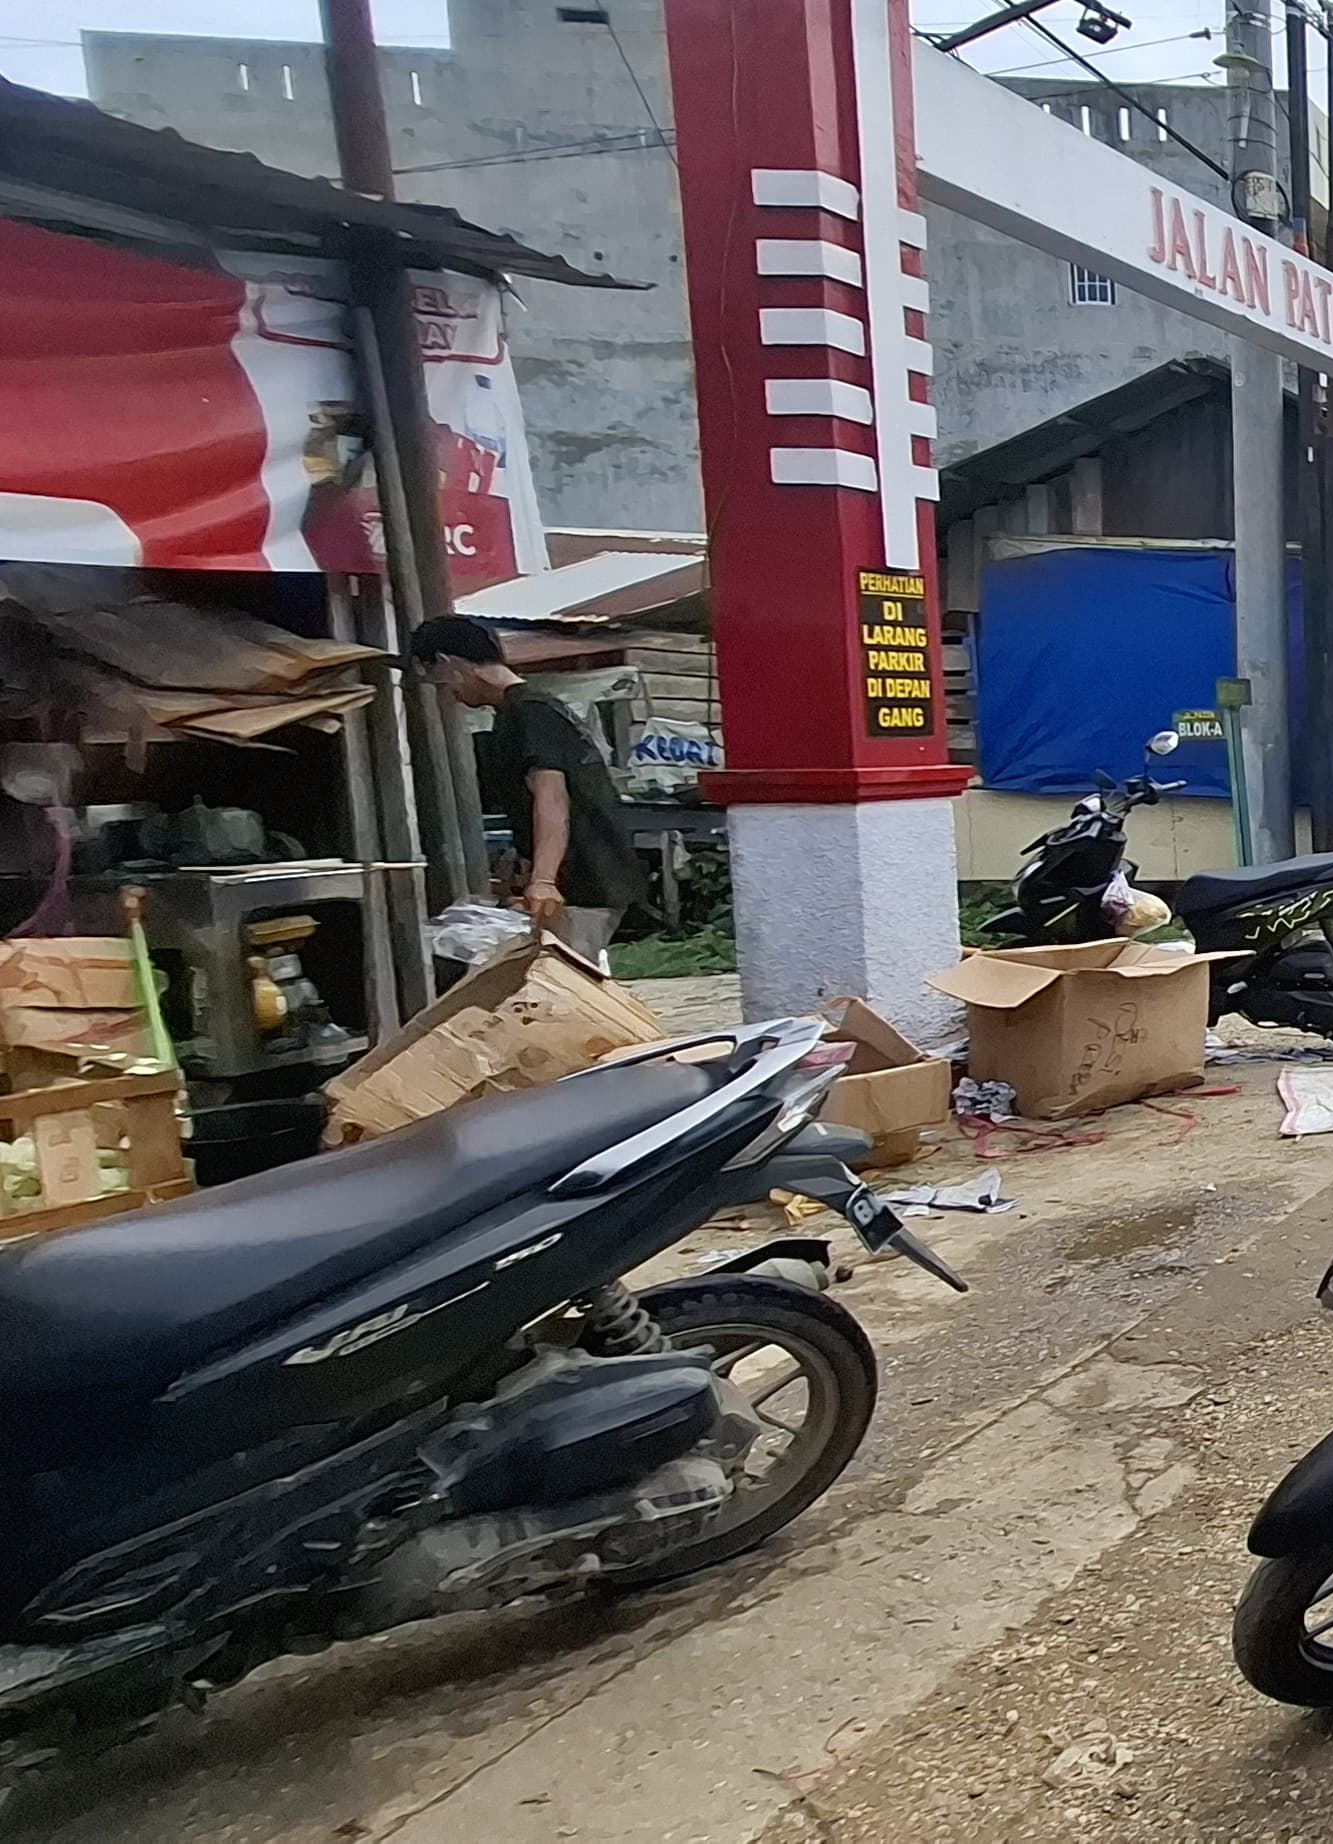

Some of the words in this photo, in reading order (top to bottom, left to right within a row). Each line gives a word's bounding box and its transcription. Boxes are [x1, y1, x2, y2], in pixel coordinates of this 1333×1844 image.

[1149, 182, 1271, 316] JALAN
[443, 524, 477, 556] RC
[859, 572, 925, 595] PERHATIAN
[882, 601, 903, 621] DI
[863, 624, 927, 647] LARANG
[868, 650, 926, 672] PARKIR
[867, 677, 882, 698] DI
[886, 678, 931, 698] DEPAN
[878, 707, 925, 728] GANG
[1179, 721, 1223, 737] BLOK-A
